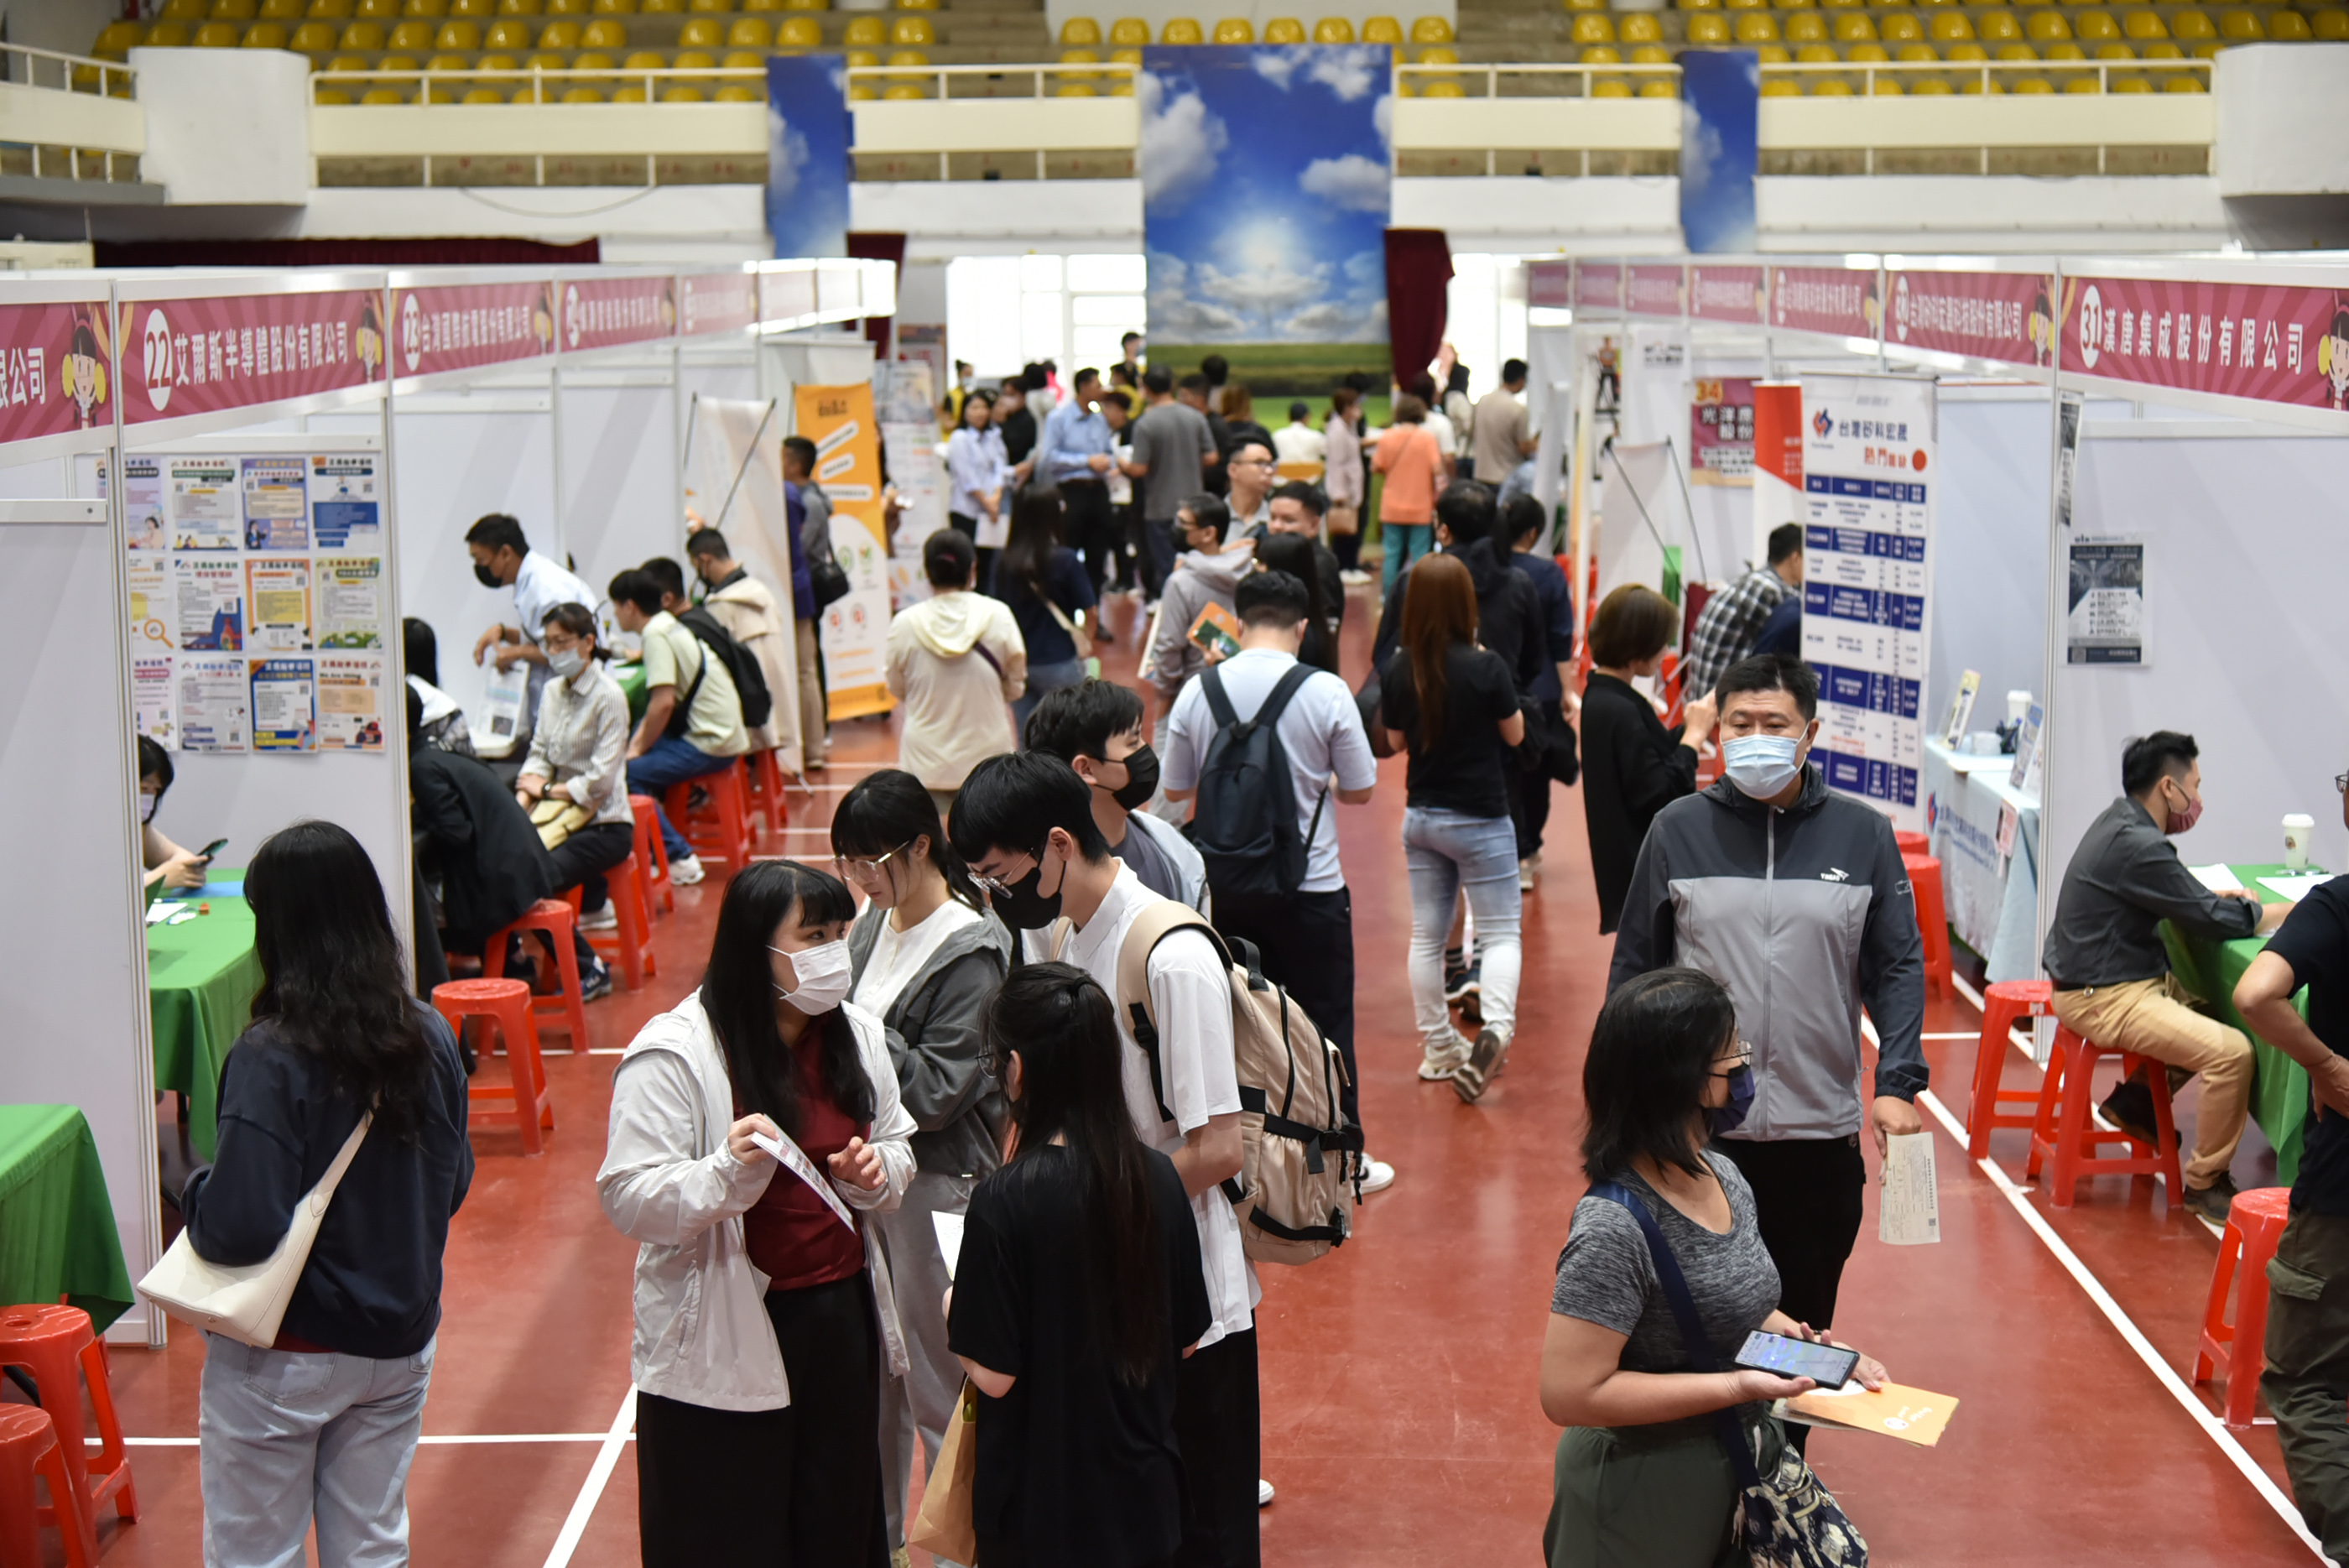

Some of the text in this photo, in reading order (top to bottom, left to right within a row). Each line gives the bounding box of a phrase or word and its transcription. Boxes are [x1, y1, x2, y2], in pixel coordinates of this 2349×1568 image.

[146, 320, 348, 389] 22 艾爾斯半導體股份有限公司
[2082, 303, 2303, 375] 31 漢唐集成股份有限公司
